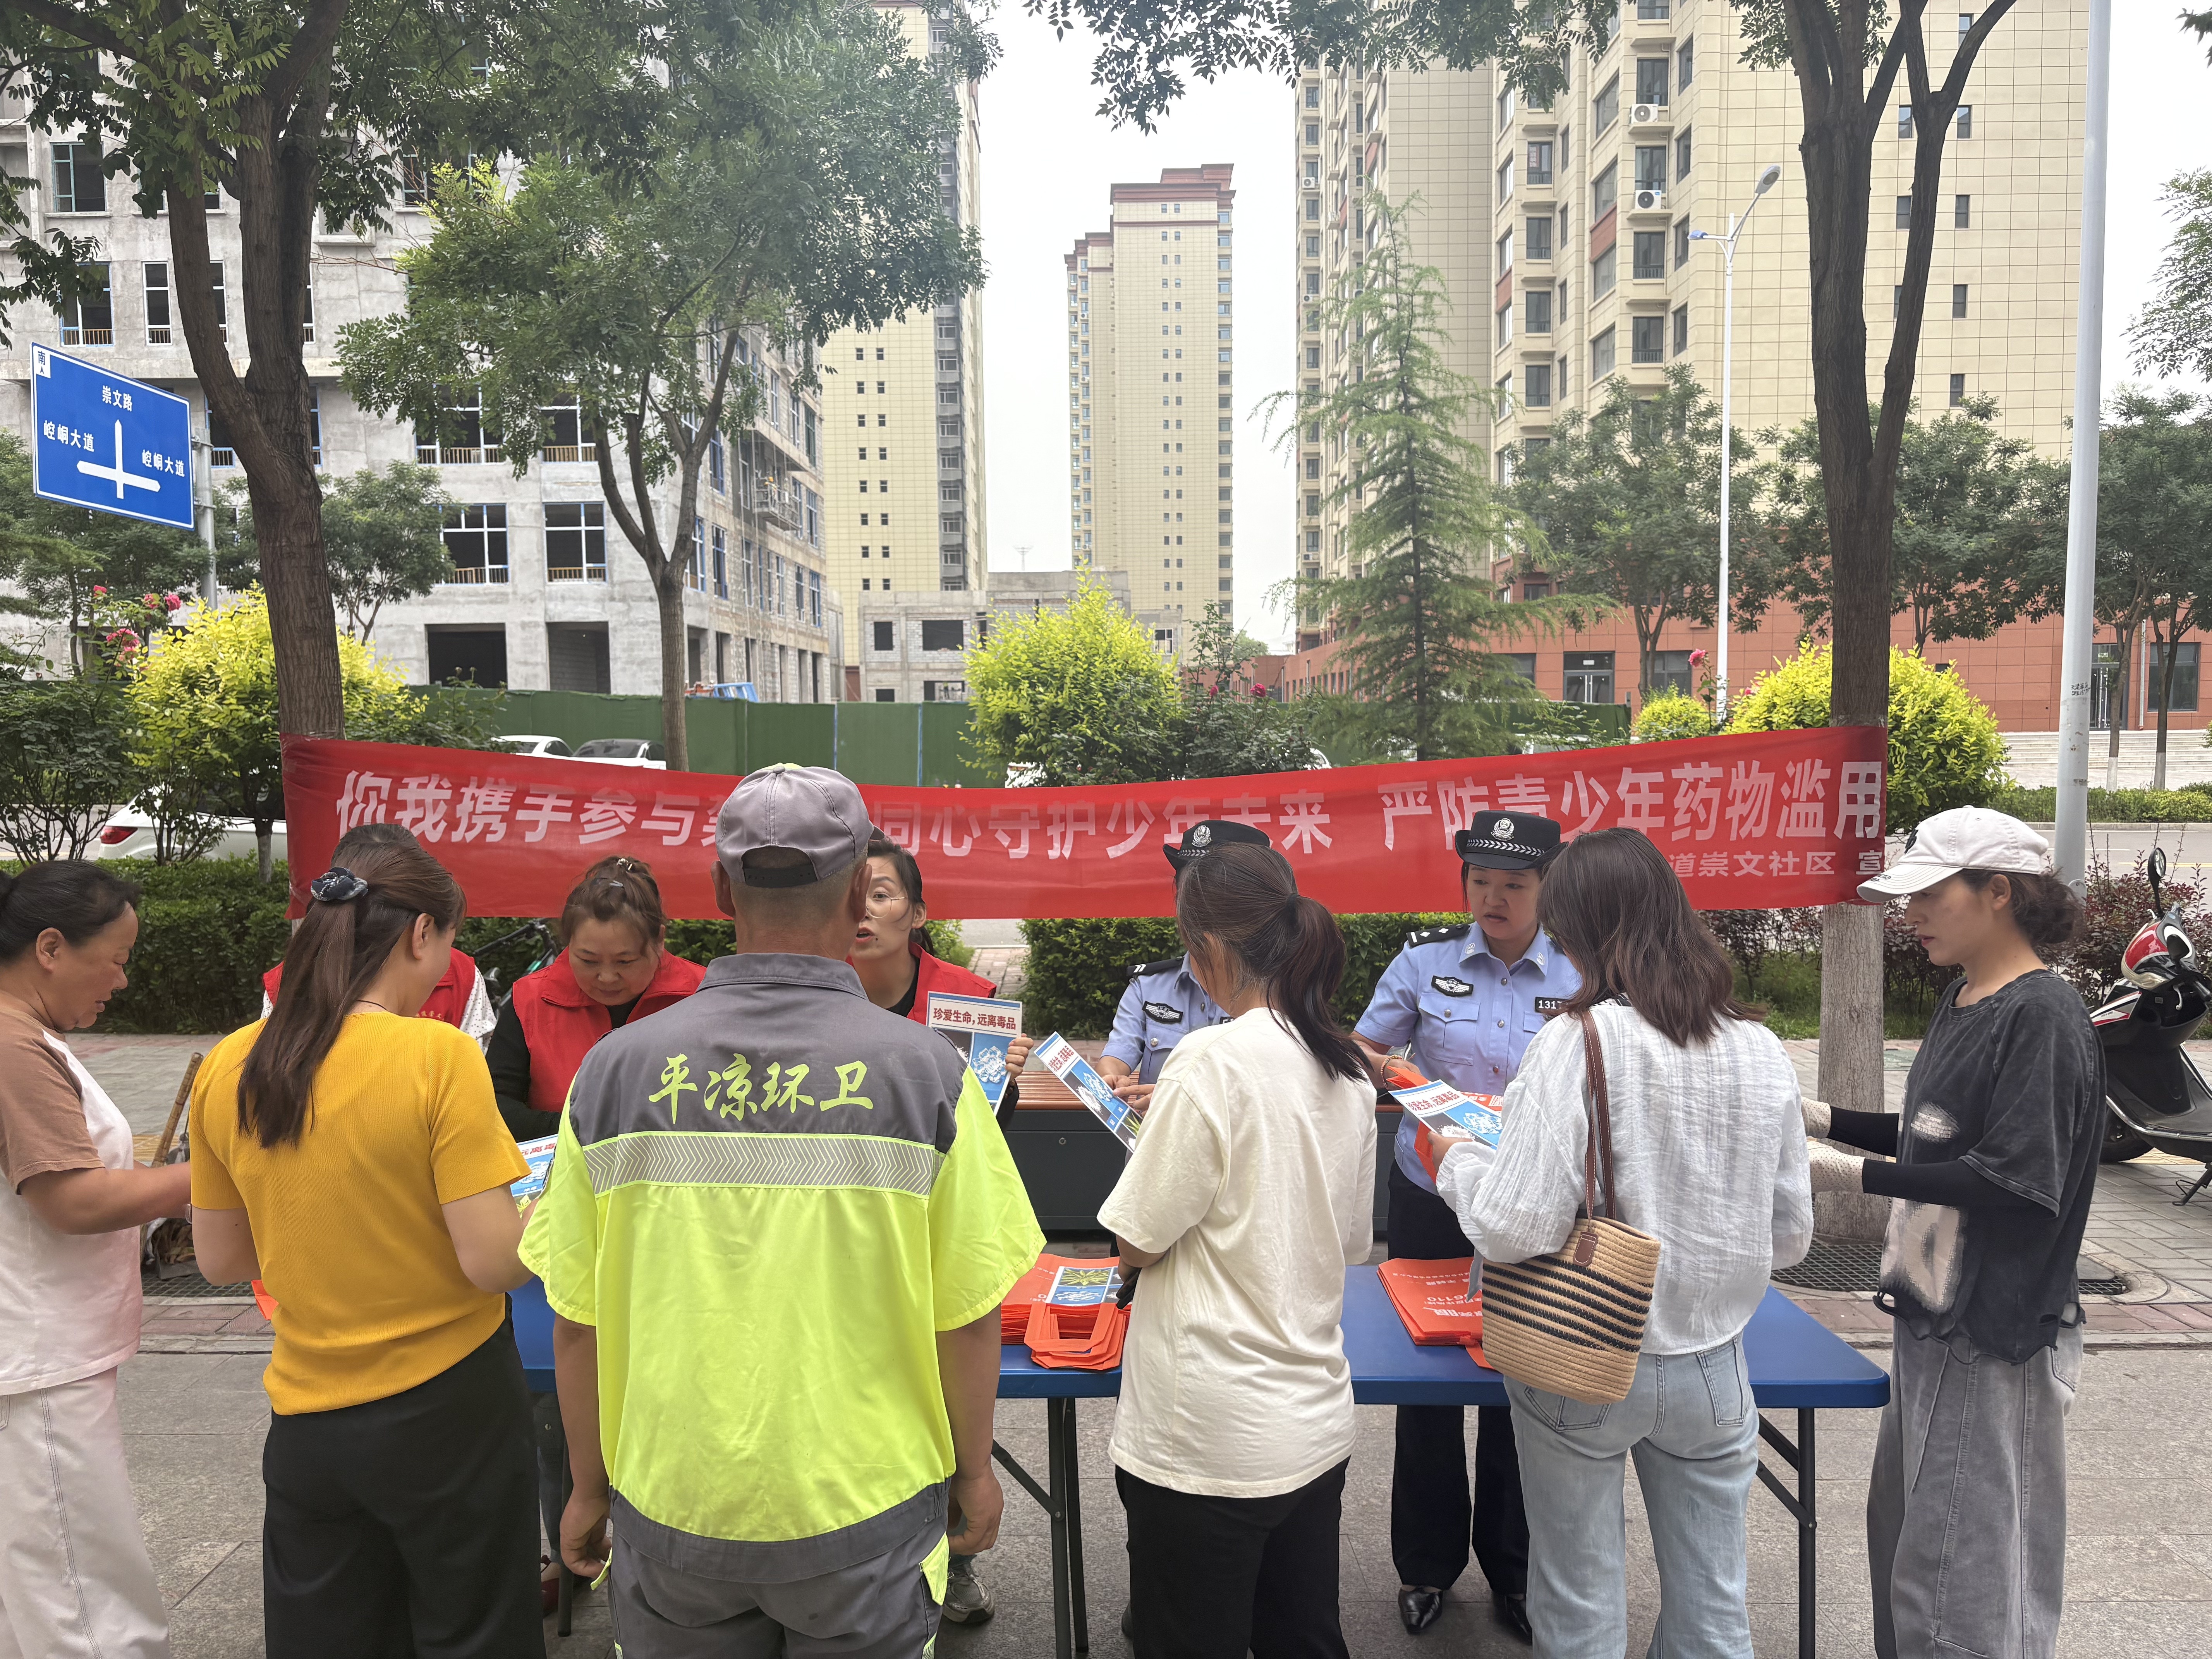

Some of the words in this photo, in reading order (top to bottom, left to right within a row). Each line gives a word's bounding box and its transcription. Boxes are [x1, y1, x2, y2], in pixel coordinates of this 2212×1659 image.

[38, 350, 46, 366] 南
[102, 385, 133, 412] 崇文路
[43, 419, 94, 452] 崆峒大道
[142, 449, 185, 477] 崆峒大道
[336, 770, 726, 847] 你我携手参与
[1377, 758, 1883, 851] 严防青少年药物滥用
[1856, 850, 1882, 875] 宣
[933, 1008, 1016, 1030] 珍爱生命，远离毒品
[648, 1053, 873, 1124] 平凉环卫
